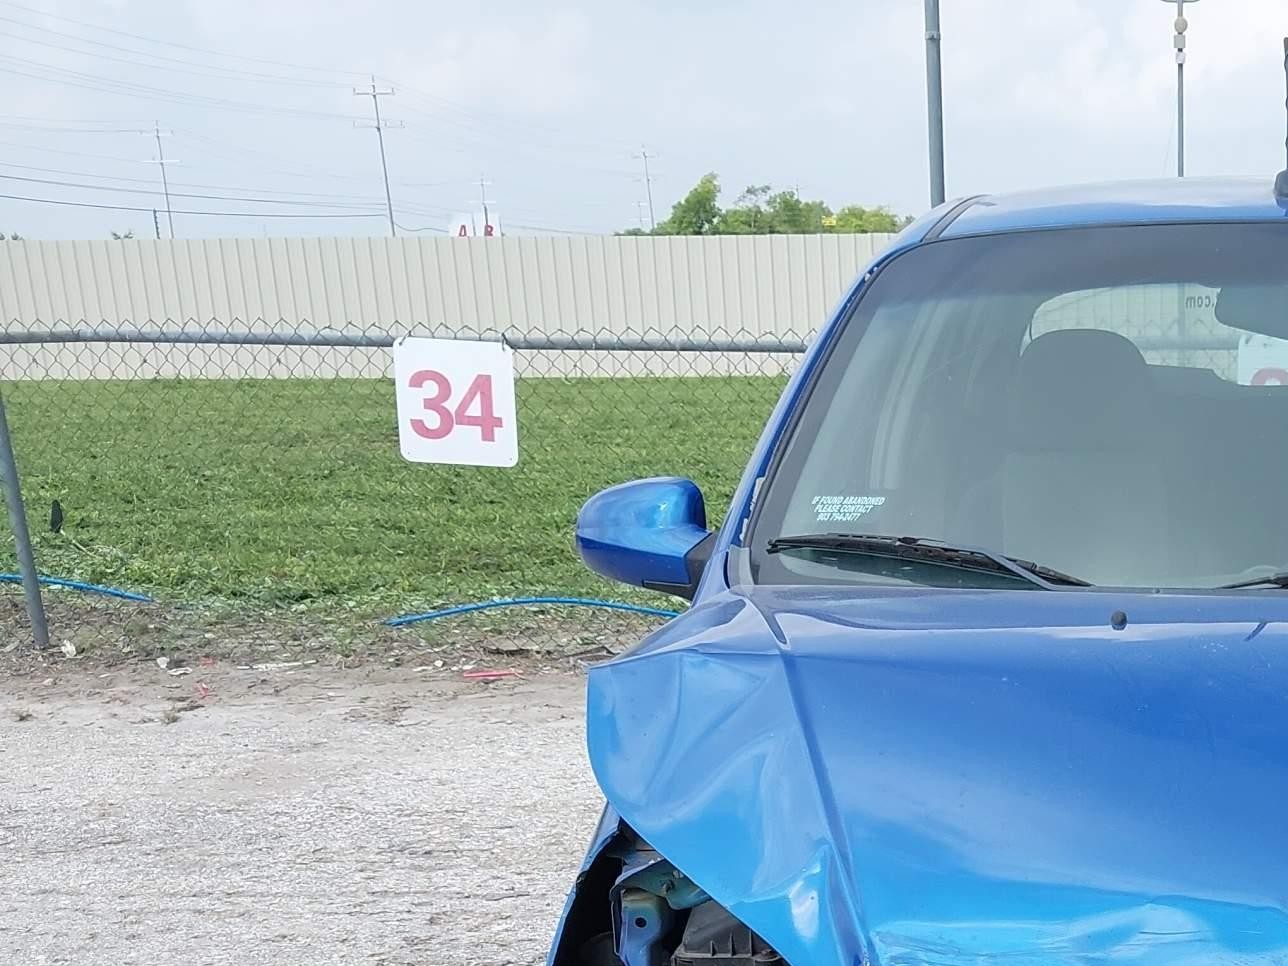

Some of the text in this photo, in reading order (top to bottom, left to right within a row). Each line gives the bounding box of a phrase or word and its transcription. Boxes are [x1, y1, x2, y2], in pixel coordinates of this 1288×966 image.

[408, 369, 503, 442] 34
[819, 496, 844, 505] FOUND
[842, 496, 886, 506] ABANDONED
[814, 504, 873, 513] PLEASE CONTACT
